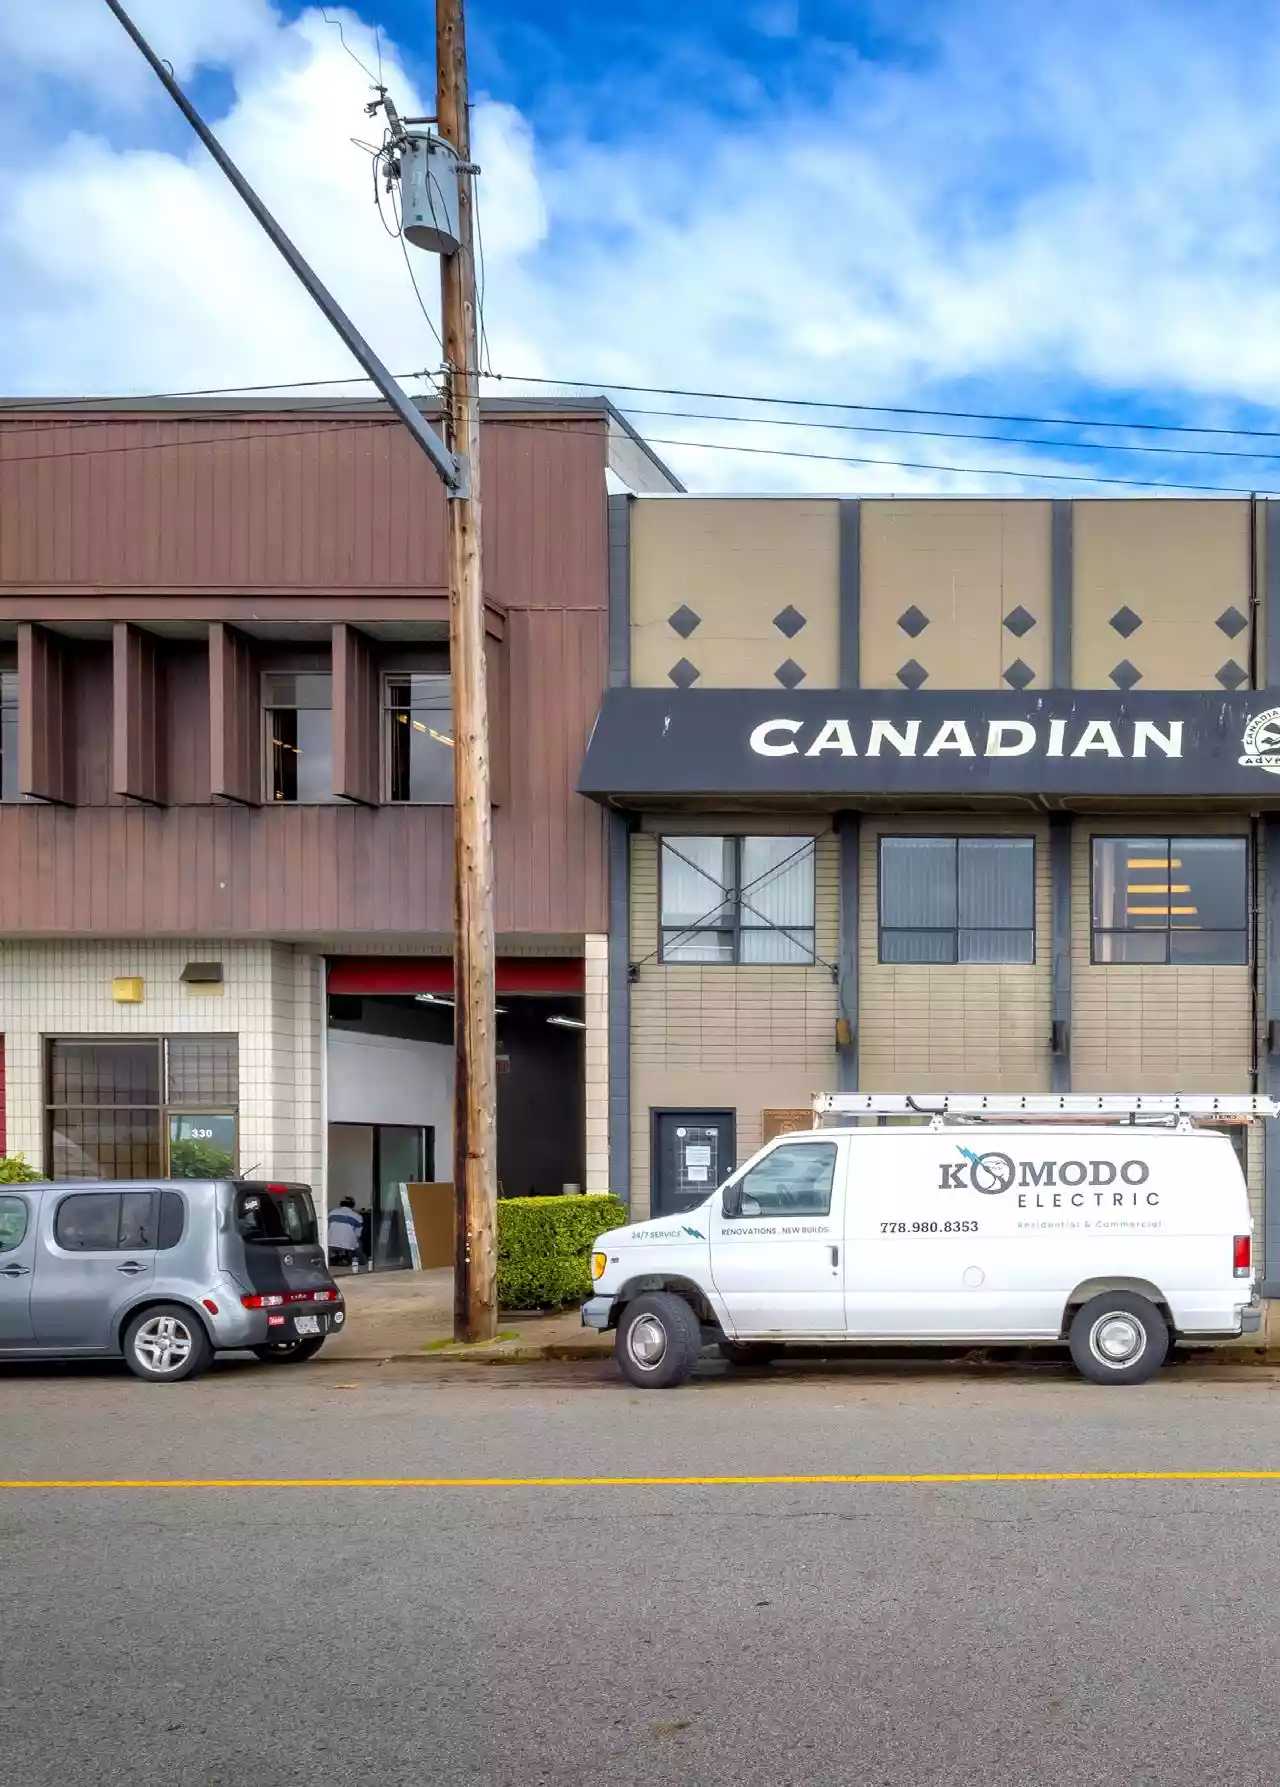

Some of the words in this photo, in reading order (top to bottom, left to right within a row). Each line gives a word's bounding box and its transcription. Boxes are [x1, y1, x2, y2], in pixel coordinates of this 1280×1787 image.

[749, 718, 1184, 758] CANADIAN
[191, 1129, 213, 1138] 330
[938, 1152, 1150, 1195] KOMODO
[1018, 1192, 1160, 1208] ELECTRIC
[880, 1221, 979, 1233] 778.980.8353
[1017, 1219, 1080, 1229] Residential
[1084, 1220, 1092, 1228] &
[1095, 1219, 1162, 1228] Commercial
[631, 1230, 650, 1239] 24/7
[650, 1230, 682, 1238] SERVICE
